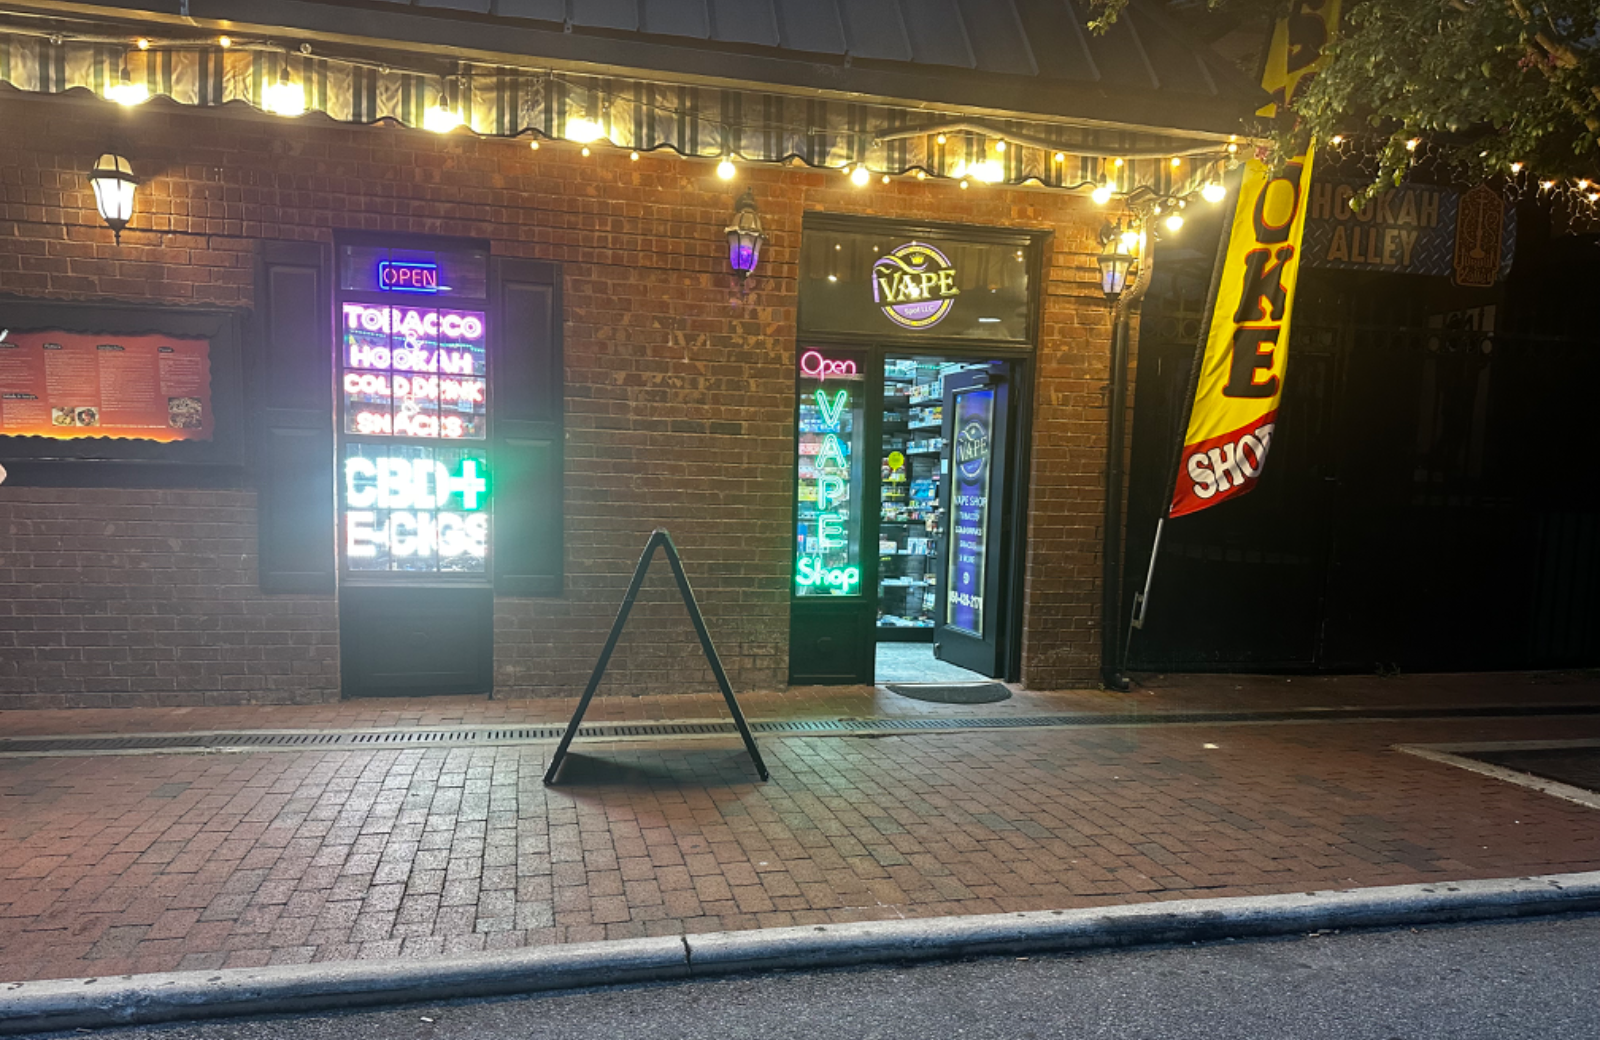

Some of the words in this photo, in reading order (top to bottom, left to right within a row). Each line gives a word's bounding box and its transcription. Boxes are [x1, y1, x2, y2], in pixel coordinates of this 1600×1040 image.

[1326, 225, 1419, 267] ALLEY
[383, 267, 436, 287] OPEN
[879, 270, 960, 303] VAPE
[343, 304, 483, 340] TOBACCO
[350, 344, 474, 375] HOOKAH
[800, 350, 857, 383] Open
[344, 374, 410, 398] COLD
[356, 411, 464, 438] SNACKS
[958, 436, 988, 462] VAPE
[814, 389, 848, 549] VAPE
[796, 557, 860, 594] Shop
